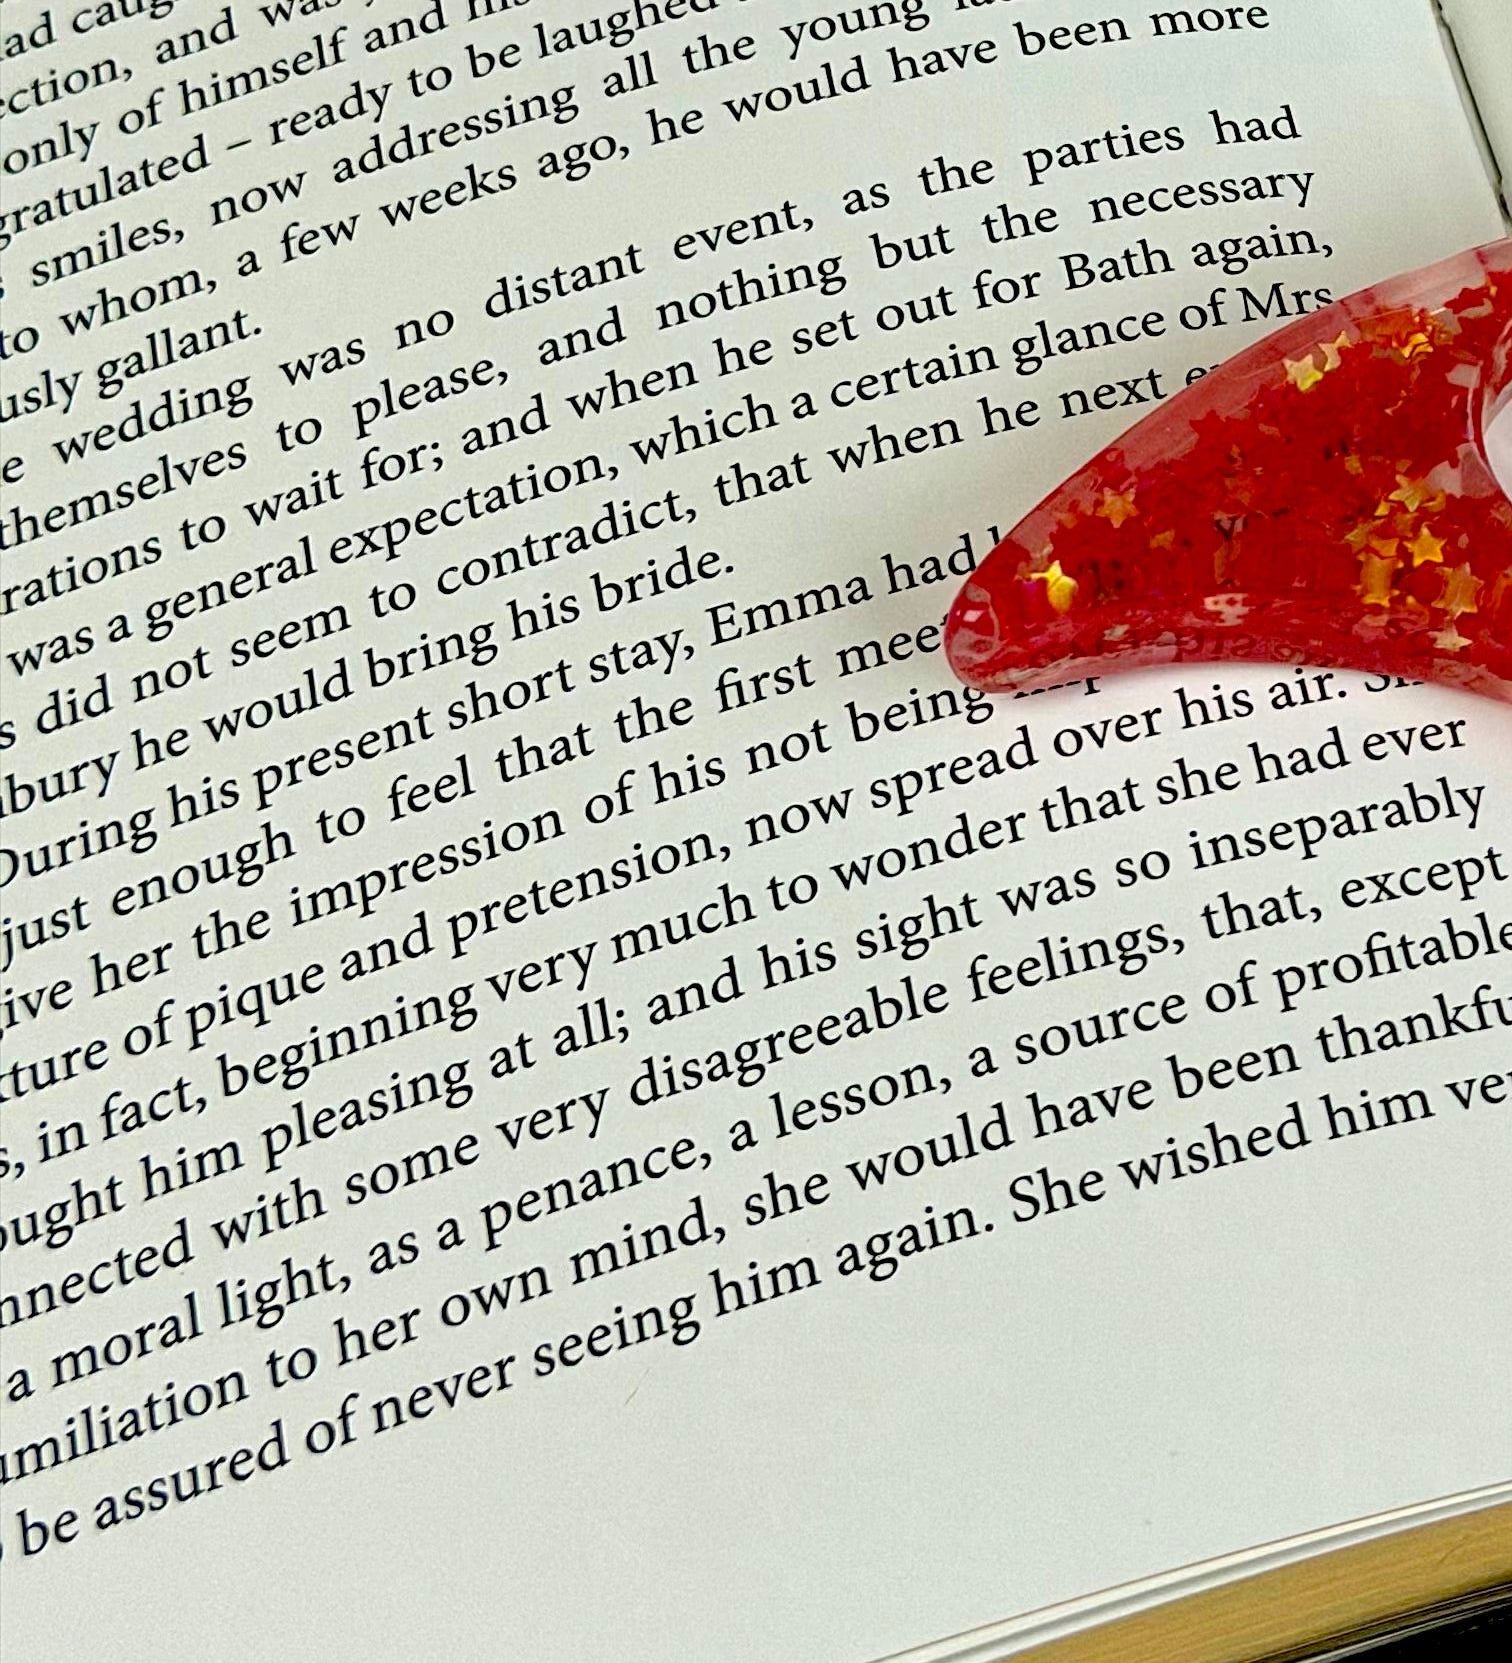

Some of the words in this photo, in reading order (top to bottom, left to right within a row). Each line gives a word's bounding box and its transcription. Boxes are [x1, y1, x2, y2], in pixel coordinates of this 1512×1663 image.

[0, 441, 247, 552] themselves
[274, 417, 323, 453] to
[351, 359, 509, 441] please,
[537, 304, 628, 366] and
[655, 254, 848, 331] nothing
[867, 223, 956, 270] but
[980, 203, 1060, 244] the
[1087, 172, 1316, 225] necessary
[29, 217, 185, 288] smiles,
[209, 170, 308, 227] now
[332, 84, 580, 184] addressing
[602, 49, 660, 98] all
[680, 33, 758, 75] the
[138, 1140, 246, 1204] him
[259, 1058, 474, 1175] pleasing
[488, 1032, 538, 1079] at
[552, 996, 630, 1057] all;
[646, 954, 746, 1026] and
[756, 937, 837, 991] his
[855, 892, 984, 962] sight
[995, 867, 1097, 917] was
[1115, 850, 1171, 888] so
[1188, 775, 1486, 871] inseparably
[15, 1507, 80, 1557] be
[93, 1417, 293, 1531] assured
[304, 1392, 360, 1455] of
[370, 1354, 517, 1436] never
[533, 1292, 702, 1378] seeing
[707, 1256, 823, 1318] him
[835, 1205, 995, 1283] again.
[1008, 1166, 1107, 1223] She
[1116, 1100, 1313, 1191] wished
[1317, 1089, 1437, 1141] him
